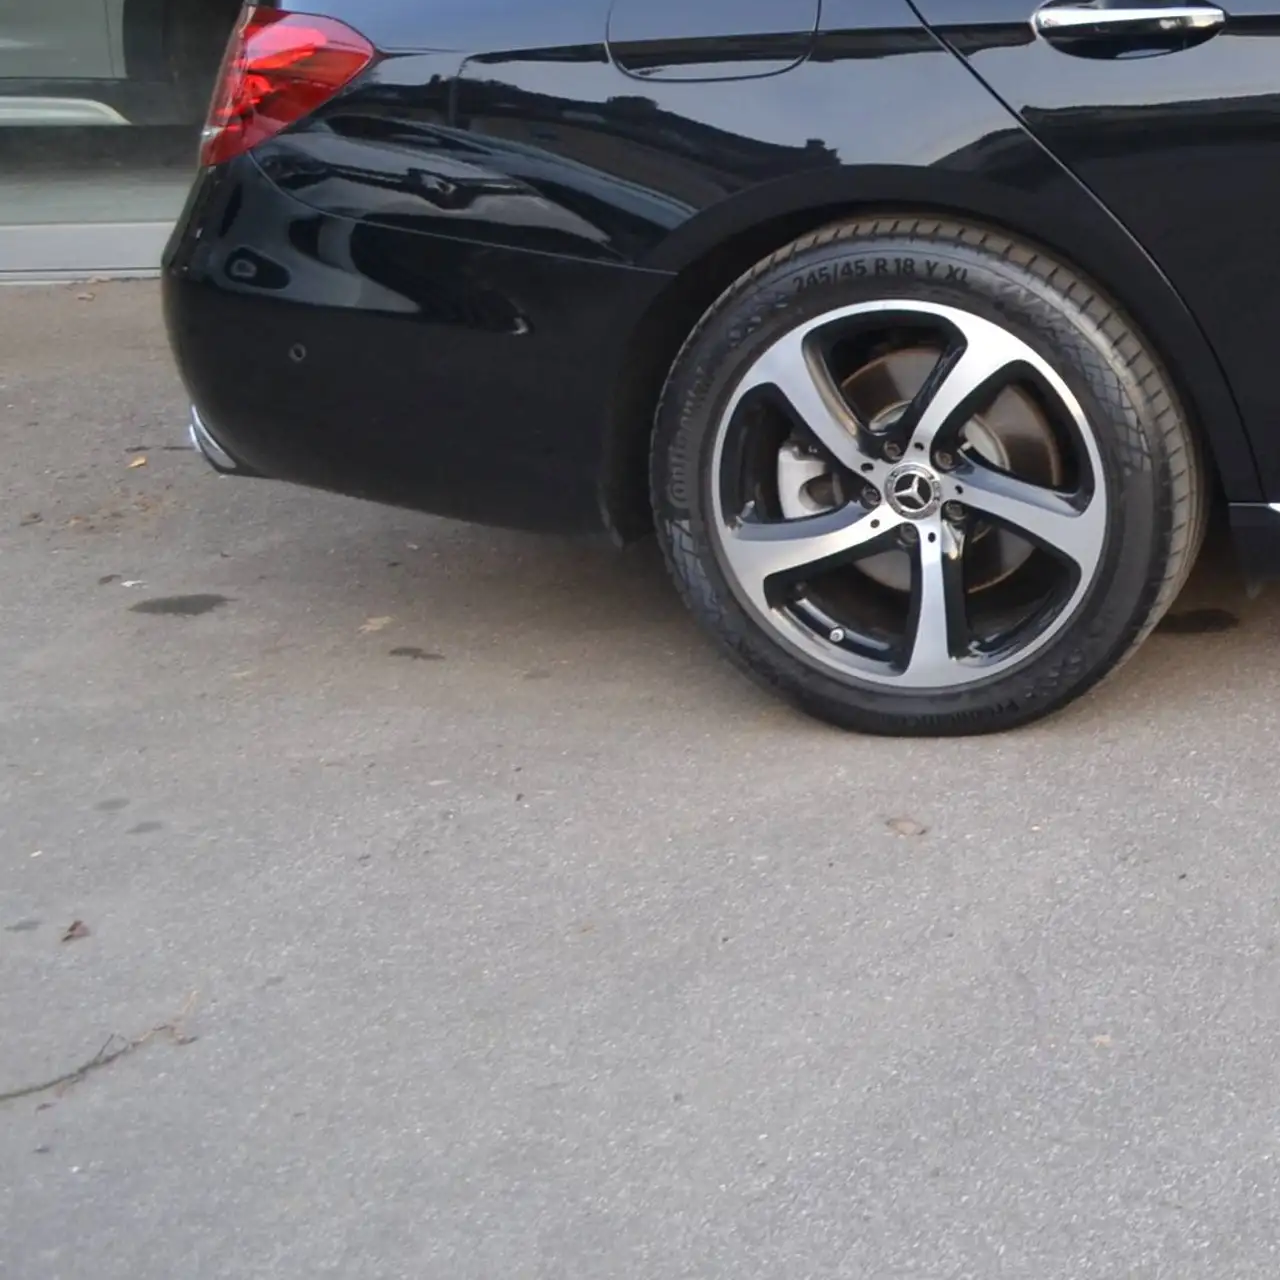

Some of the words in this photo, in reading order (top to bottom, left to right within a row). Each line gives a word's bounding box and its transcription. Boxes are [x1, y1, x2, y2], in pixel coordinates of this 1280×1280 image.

[793, 258, 867, 293] 245/45
[874, 257, 889, 277] R
[895, 256, 916, 276] 18
